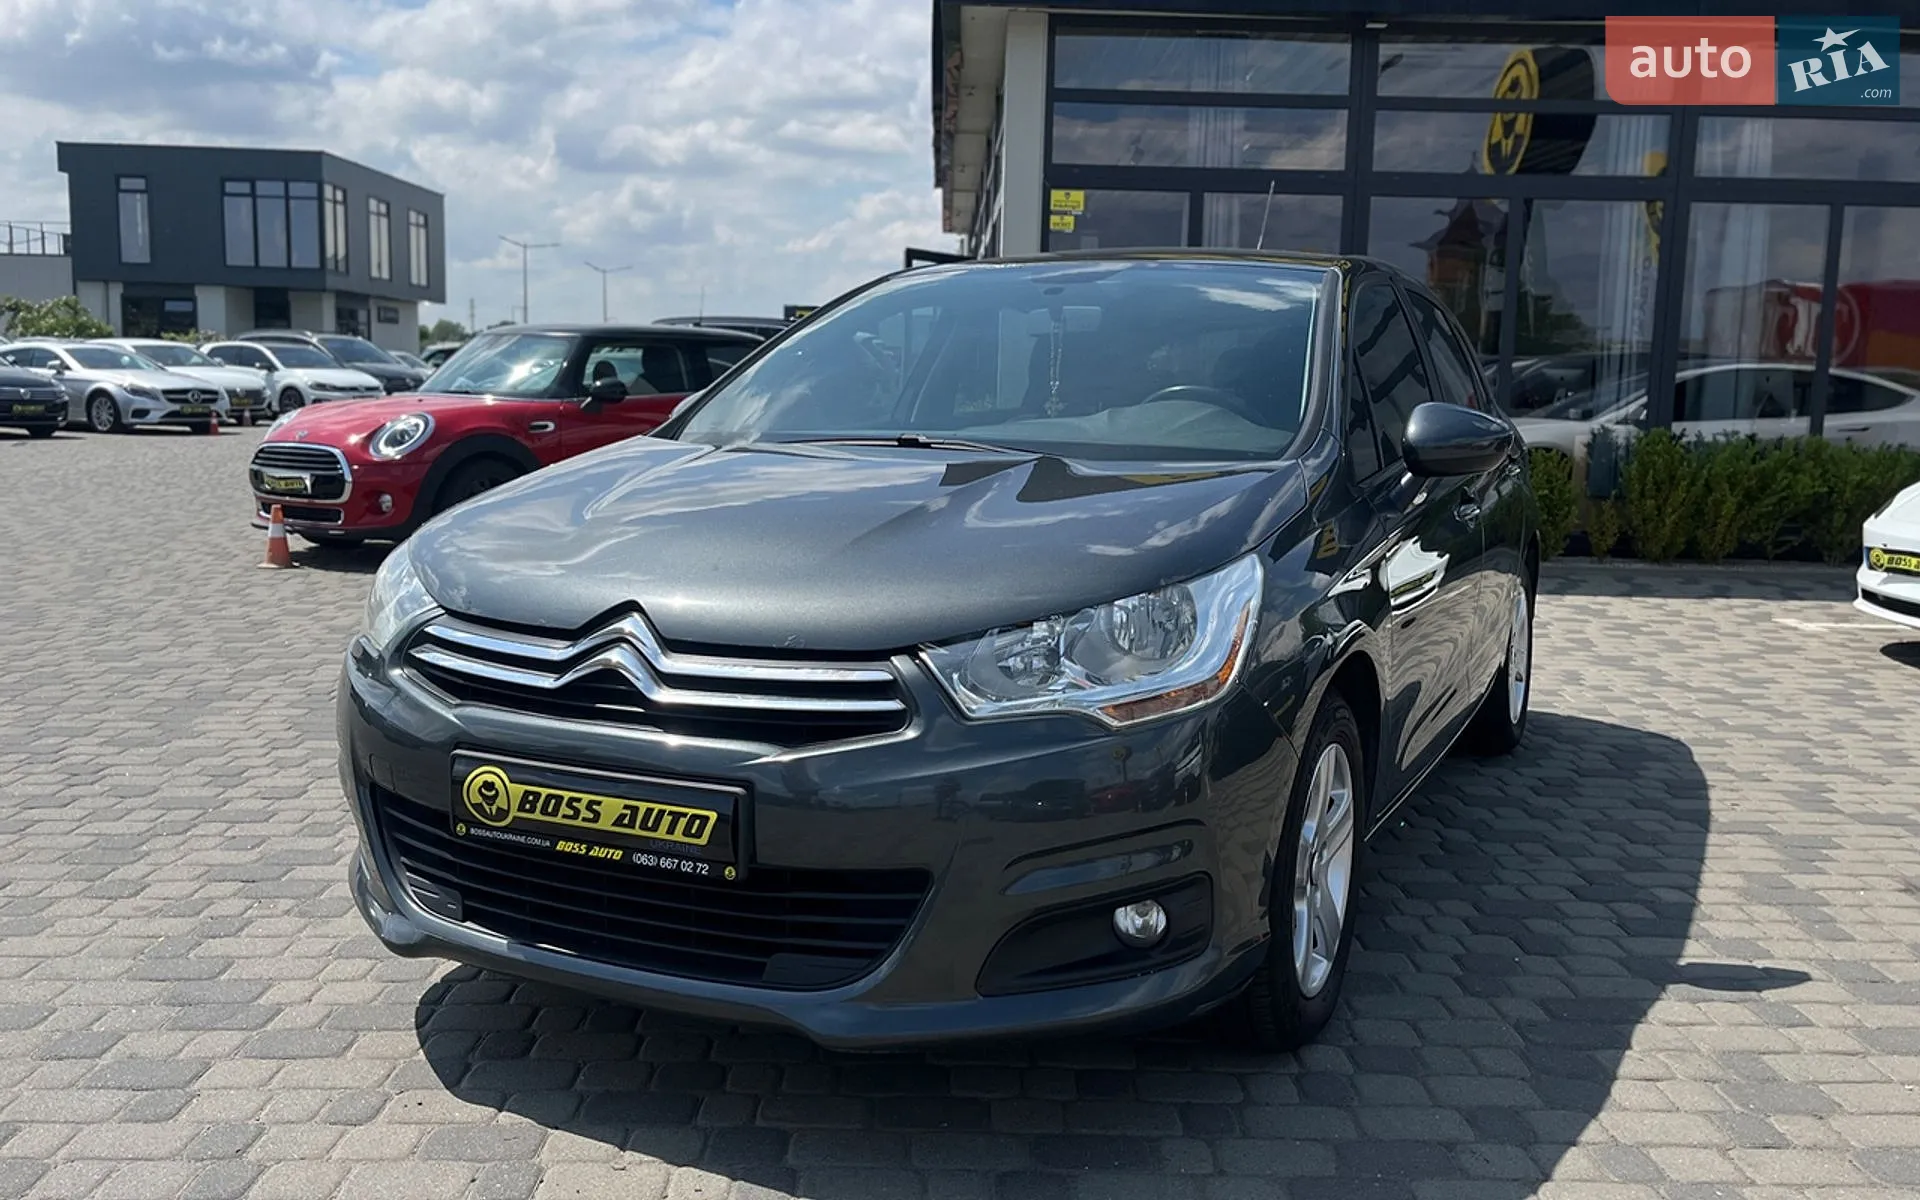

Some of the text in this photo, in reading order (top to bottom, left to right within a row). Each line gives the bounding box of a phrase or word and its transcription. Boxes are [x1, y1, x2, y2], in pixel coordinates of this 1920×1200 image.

[516, 790, 711, 840] BOSS AUTO
[556, 840, 624, 861] BOSS AUTO
[632, 852, 710, 875] (063) 667 02 72
